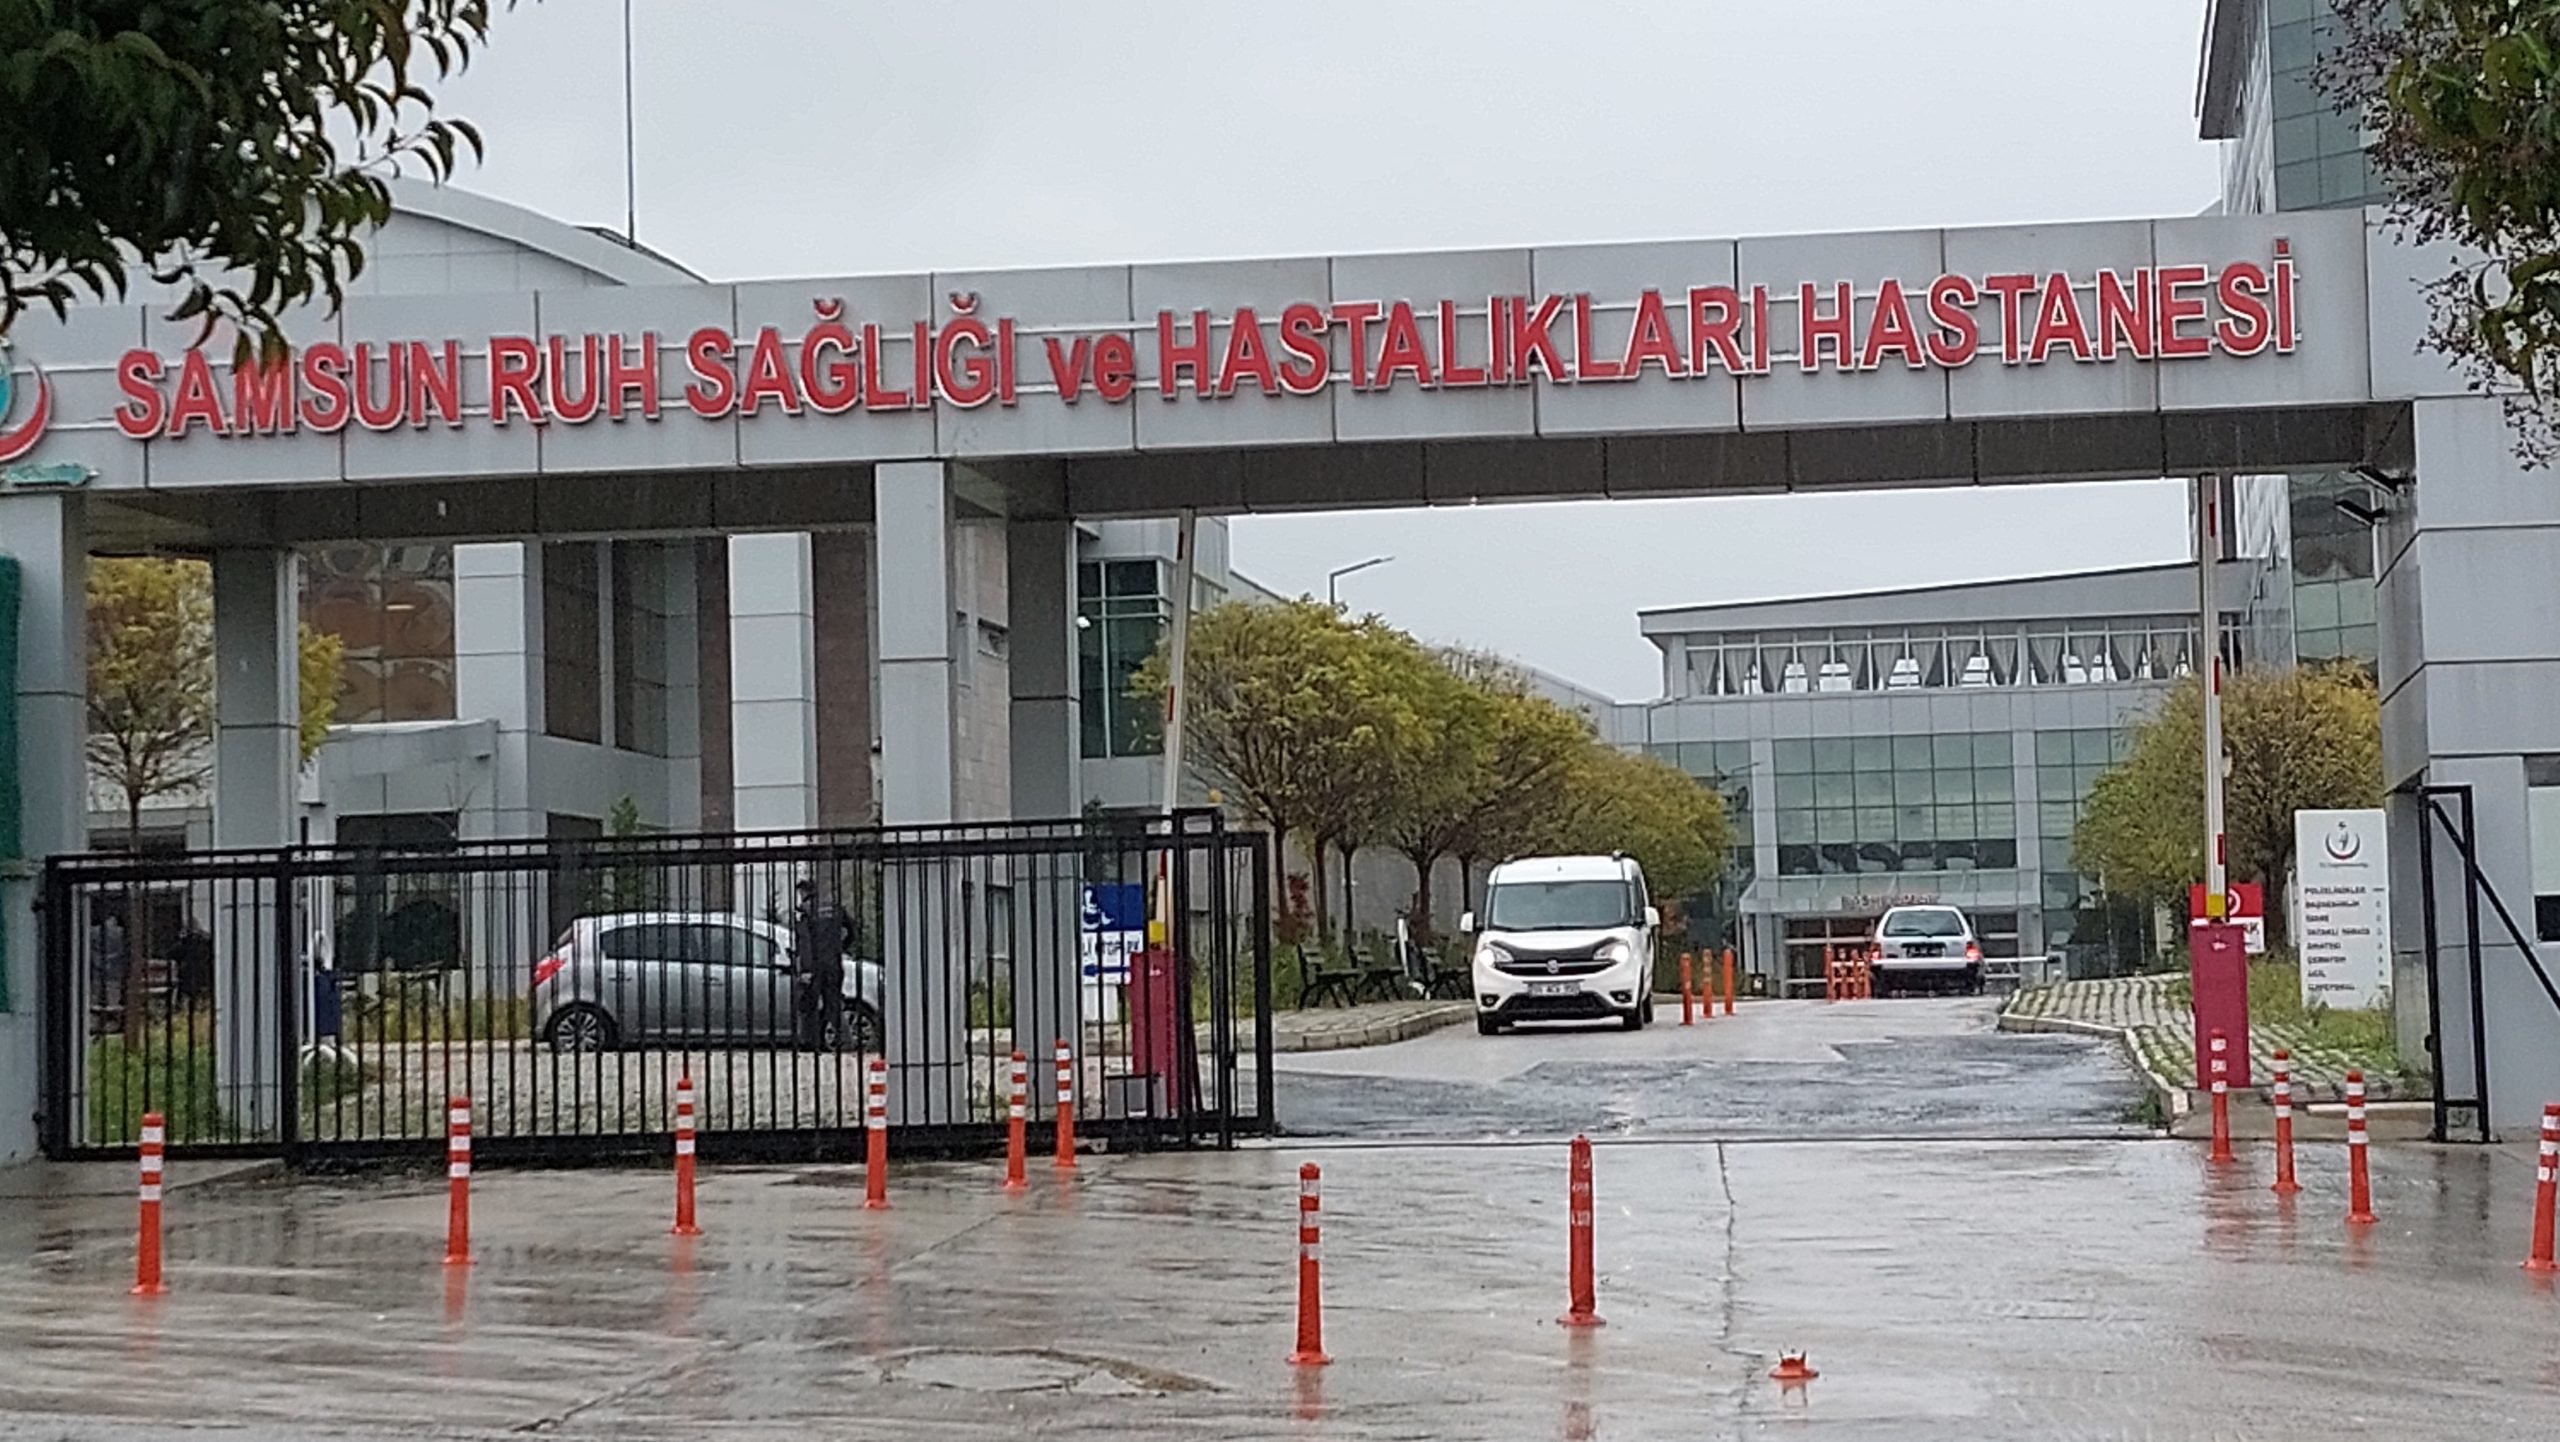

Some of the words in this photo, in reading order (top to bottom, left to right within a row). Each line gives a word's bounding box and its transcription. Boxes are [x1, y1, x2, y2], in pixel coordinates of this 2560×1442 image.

[115, 339, 461, 437] SAMSUN
[489, 333, 659, 423] RUH
[685, 297, 1017, 416] SAĞLIĞI
[1044, 333, 1136, 402] ve
[1158, 285, 1769, 397] HASTALIKLARI
[1801, 238, 2295, 370] HASTANESİ
